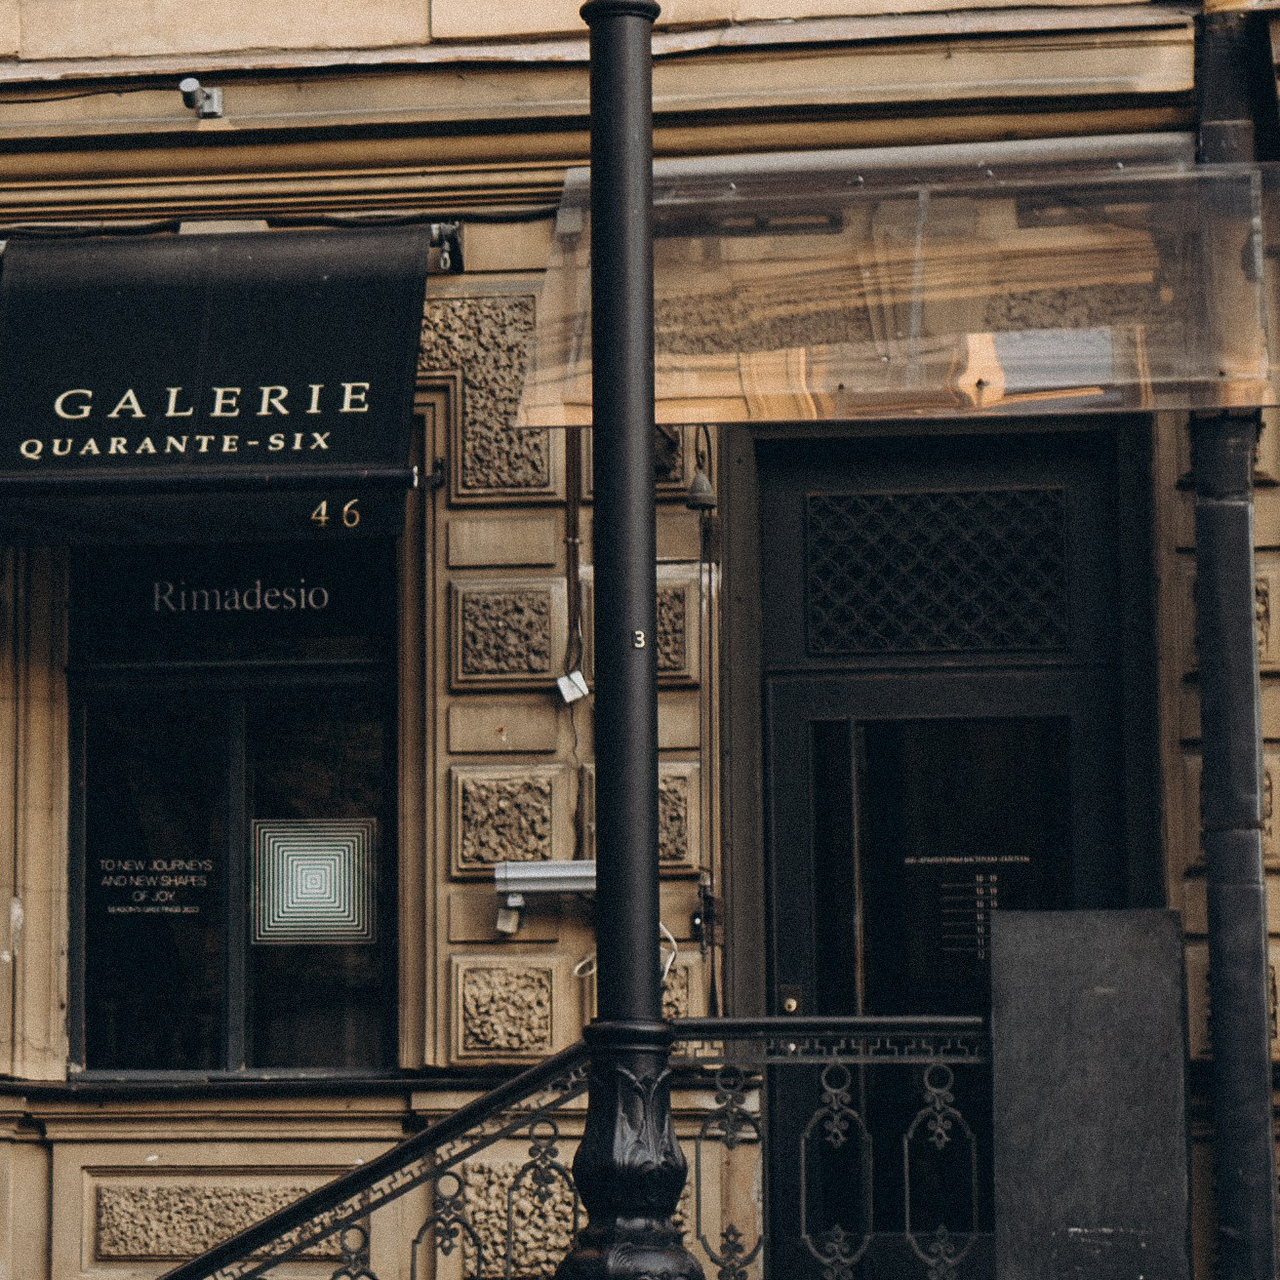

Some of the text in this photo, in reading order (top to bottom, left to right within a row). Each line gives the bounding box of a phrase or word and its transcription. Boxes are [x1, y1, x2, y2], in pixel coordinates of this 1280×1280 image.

[53, 381, 371, 420] GALERIE
[19, 431, 331, 461] QUARANTE-SIX
[152, 577, 331, 614] Rimadesio
[633, 629, 646, 649] 3
